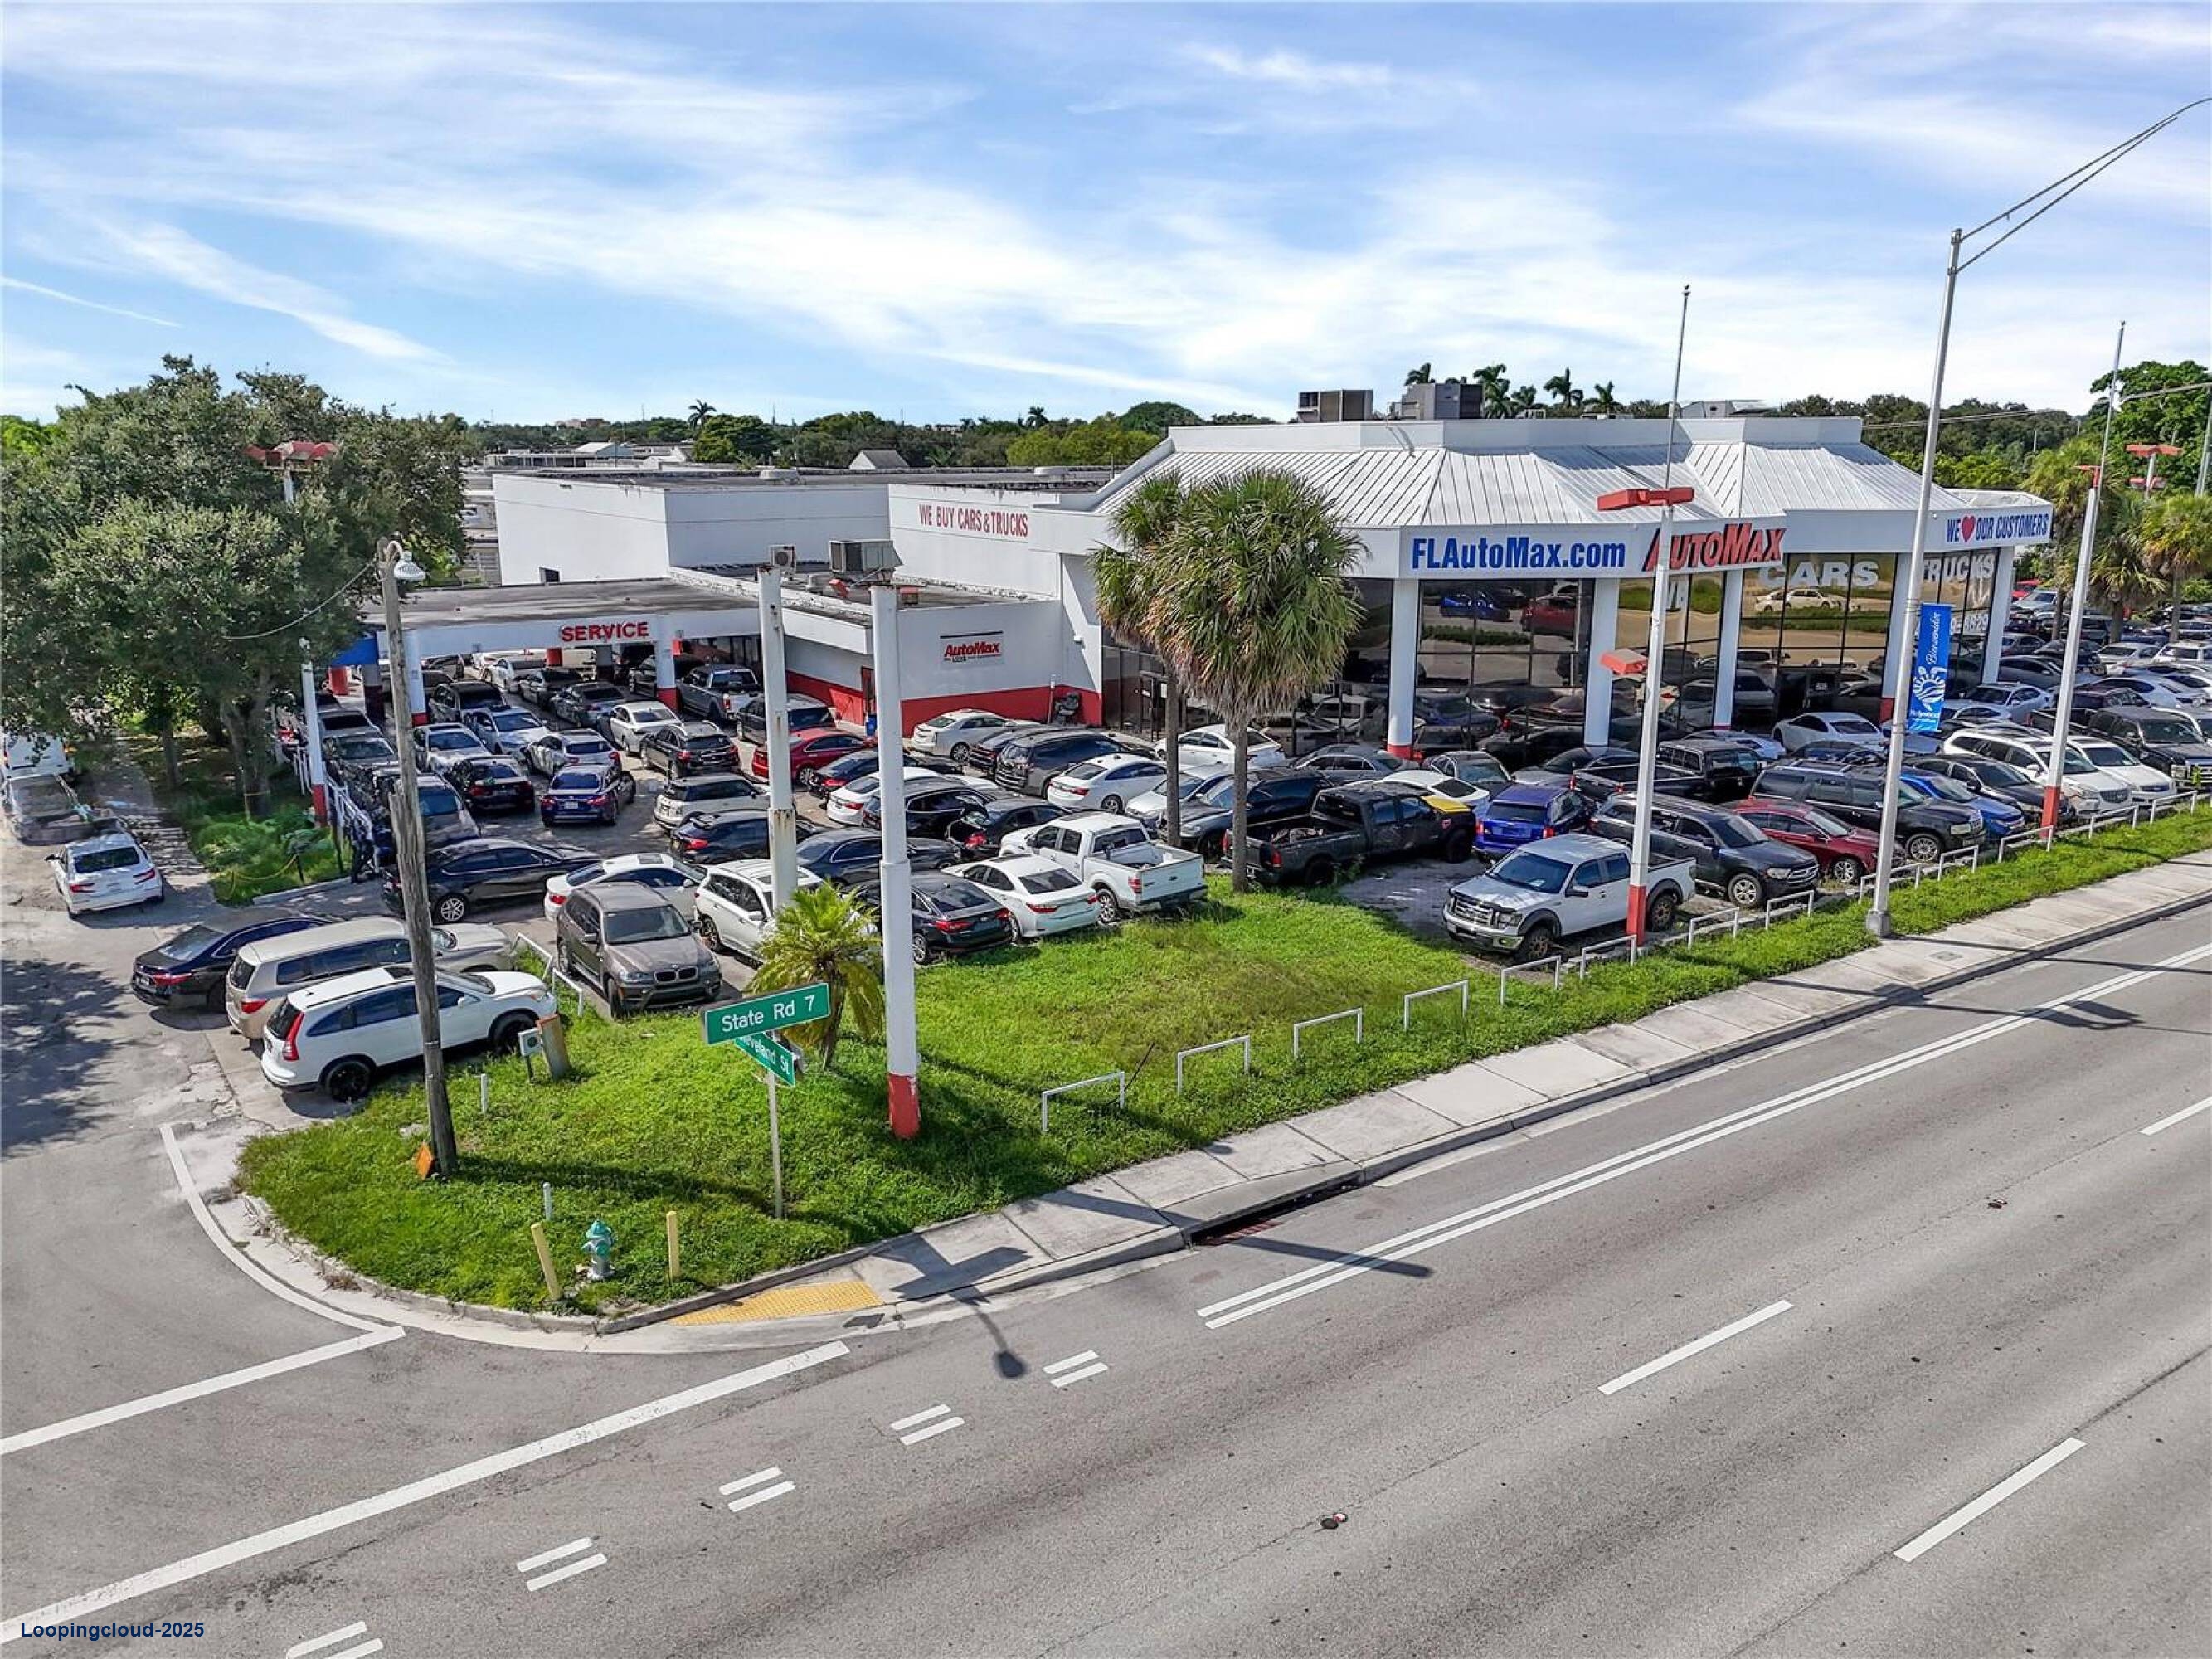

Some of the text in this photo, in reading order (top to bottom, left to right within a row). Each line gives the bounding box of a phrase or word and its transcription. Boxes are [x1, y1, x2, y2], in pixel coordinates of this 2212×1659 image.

[919, 504, 932, 526] WE
[936, 506, 955, 528] BUY
[1946, 513, 2049, 542] WE OUR CUSTOMERS
[1412, 537, 1626, 570] FLAutoMax.com
[1758, 561, 1879, 588] CARS
[562, 621, 649, 642] SERVICE
[944, 641, 1000, 658] AutoMax
[722, 995, 815, 1032] State Rd 7
[780, 1054, 790, 1075] St
